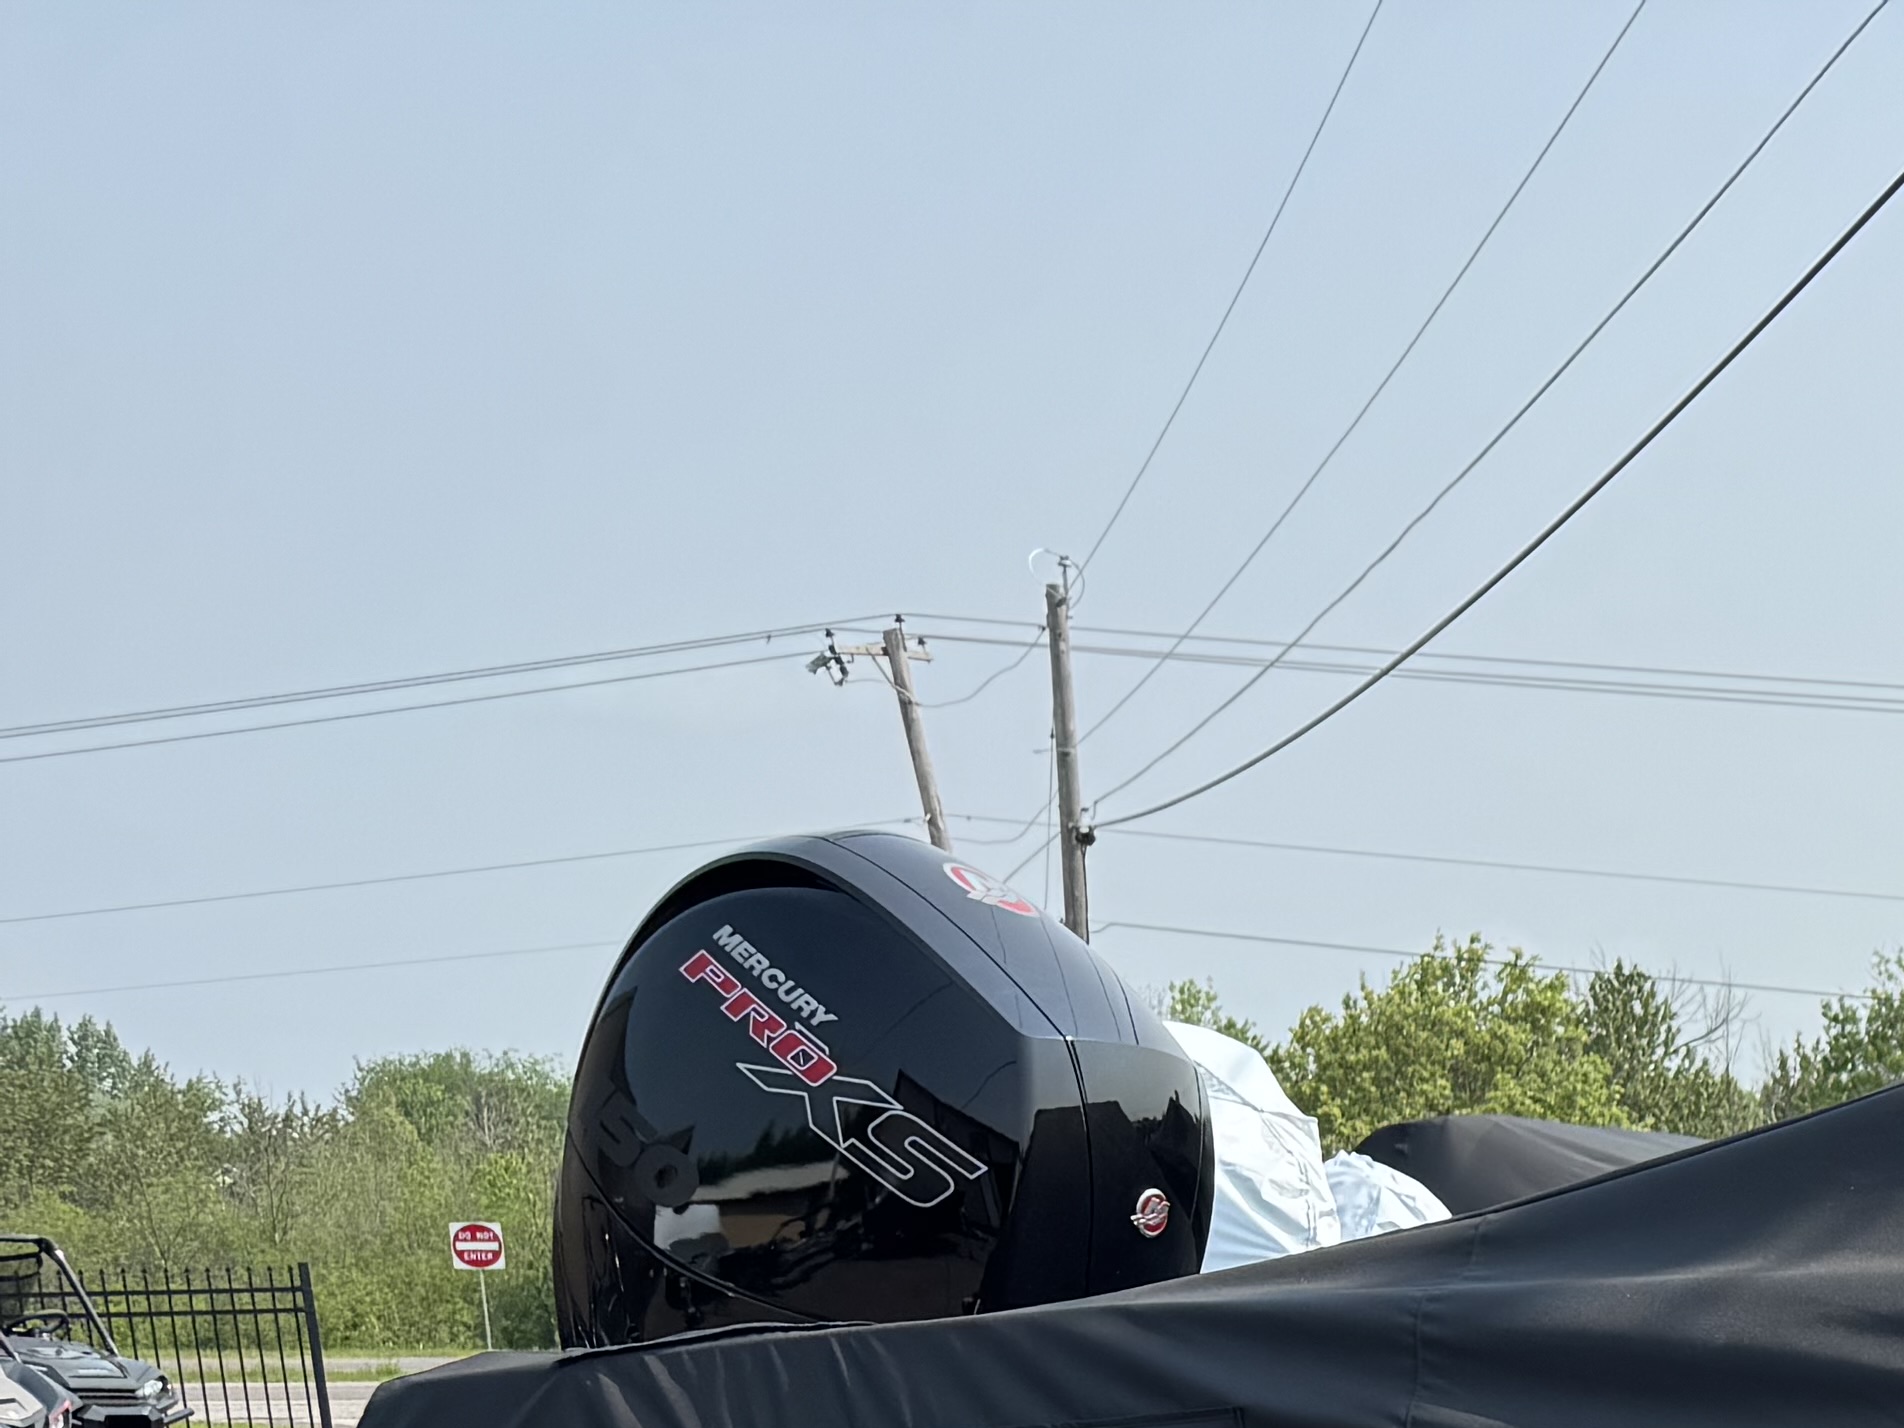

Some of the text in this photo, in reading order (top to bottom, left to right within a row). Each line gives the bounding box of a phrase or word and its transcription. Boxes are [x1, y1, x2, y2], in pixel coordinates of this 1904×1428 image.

[679, 949, 837, 1087] PRO
[712, 924, 838, 1027] MERCURY
[736, 1021, 988, 1208] XS
[458, 1231, 494, 1240] DO NOT
[464, 1251, 493, 1261] ENTER
